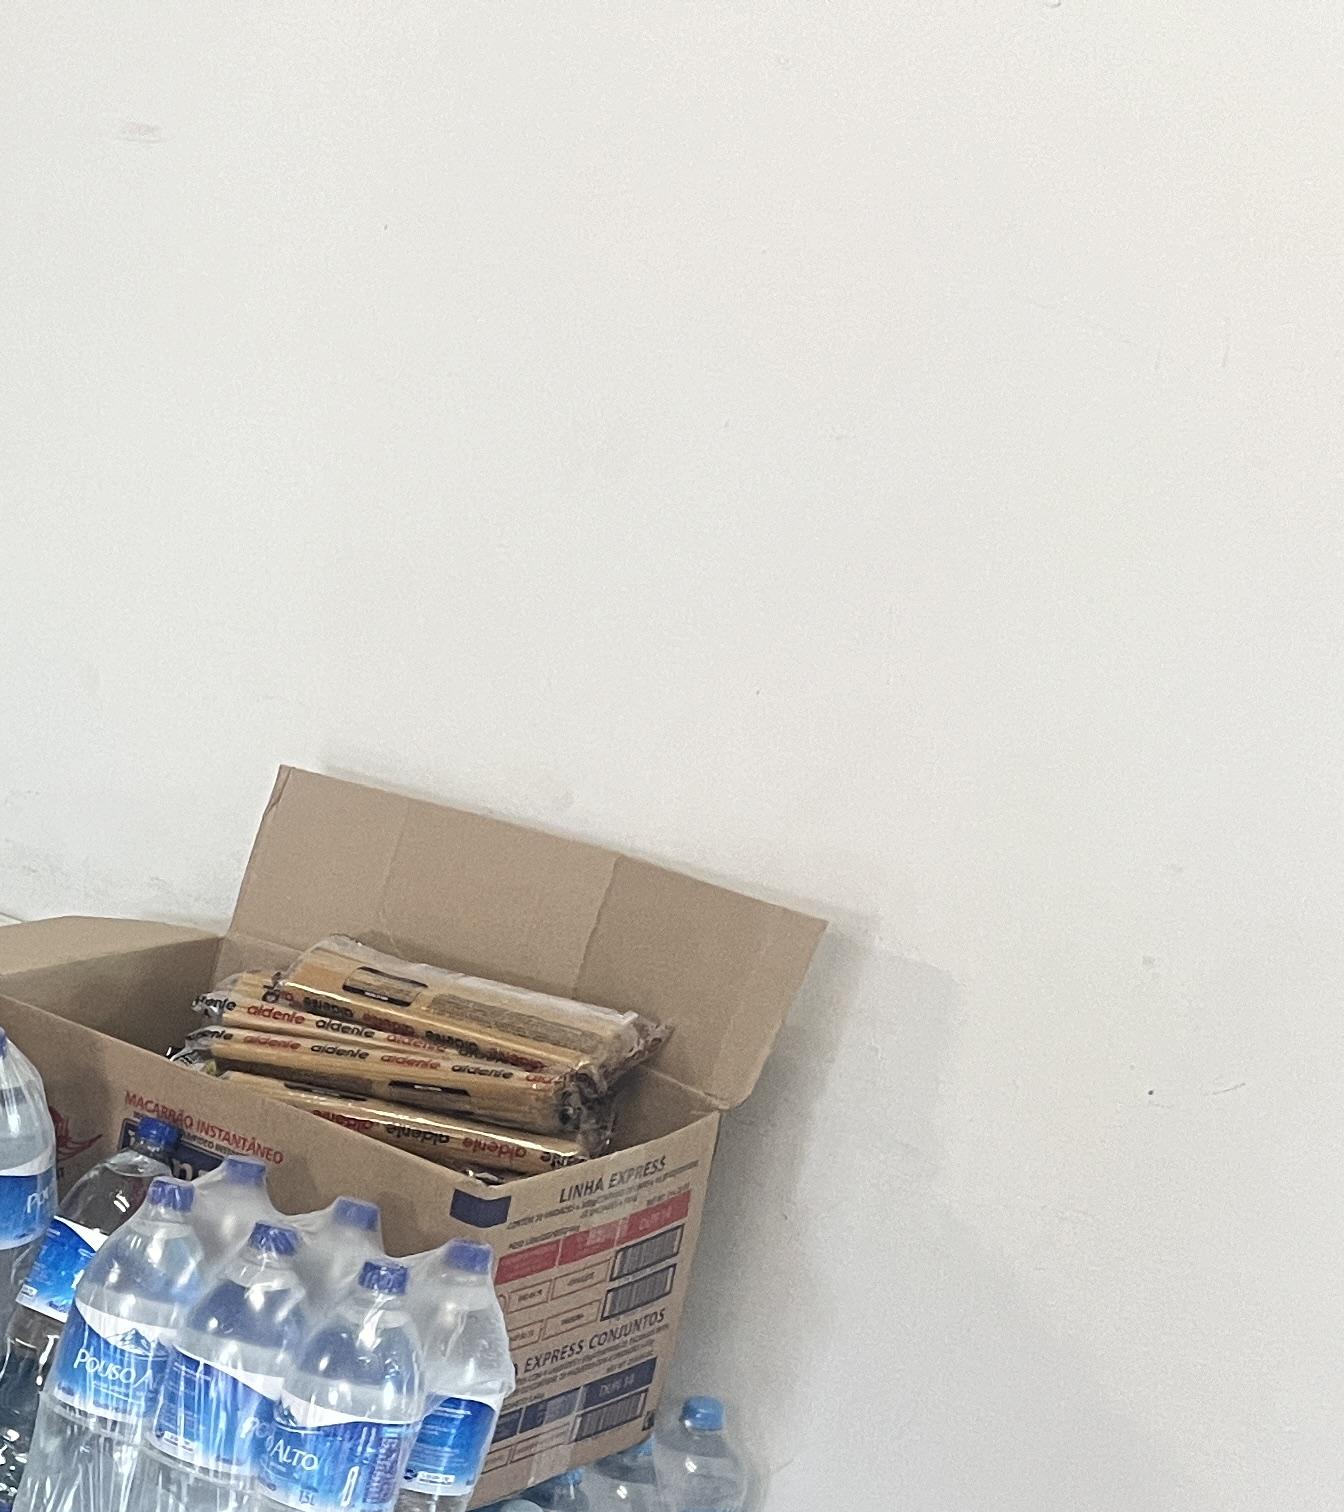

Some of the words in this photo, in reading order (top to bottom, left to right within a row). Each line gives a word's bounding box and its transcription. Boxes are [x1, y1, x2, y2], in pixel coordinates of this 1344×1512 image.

[124, 1090, 194, 1130] MACARRÃO
[196, 1118, 285, 1165] INSTANTÂNEO
[559, 1176, 605, 1204] LINHA
[607, 1154, 667, 1190] EXPRESS
[524, 1338, 585, 1373] EXPRESS
[588, 1308, 666, 1350] CONJUNTOS
